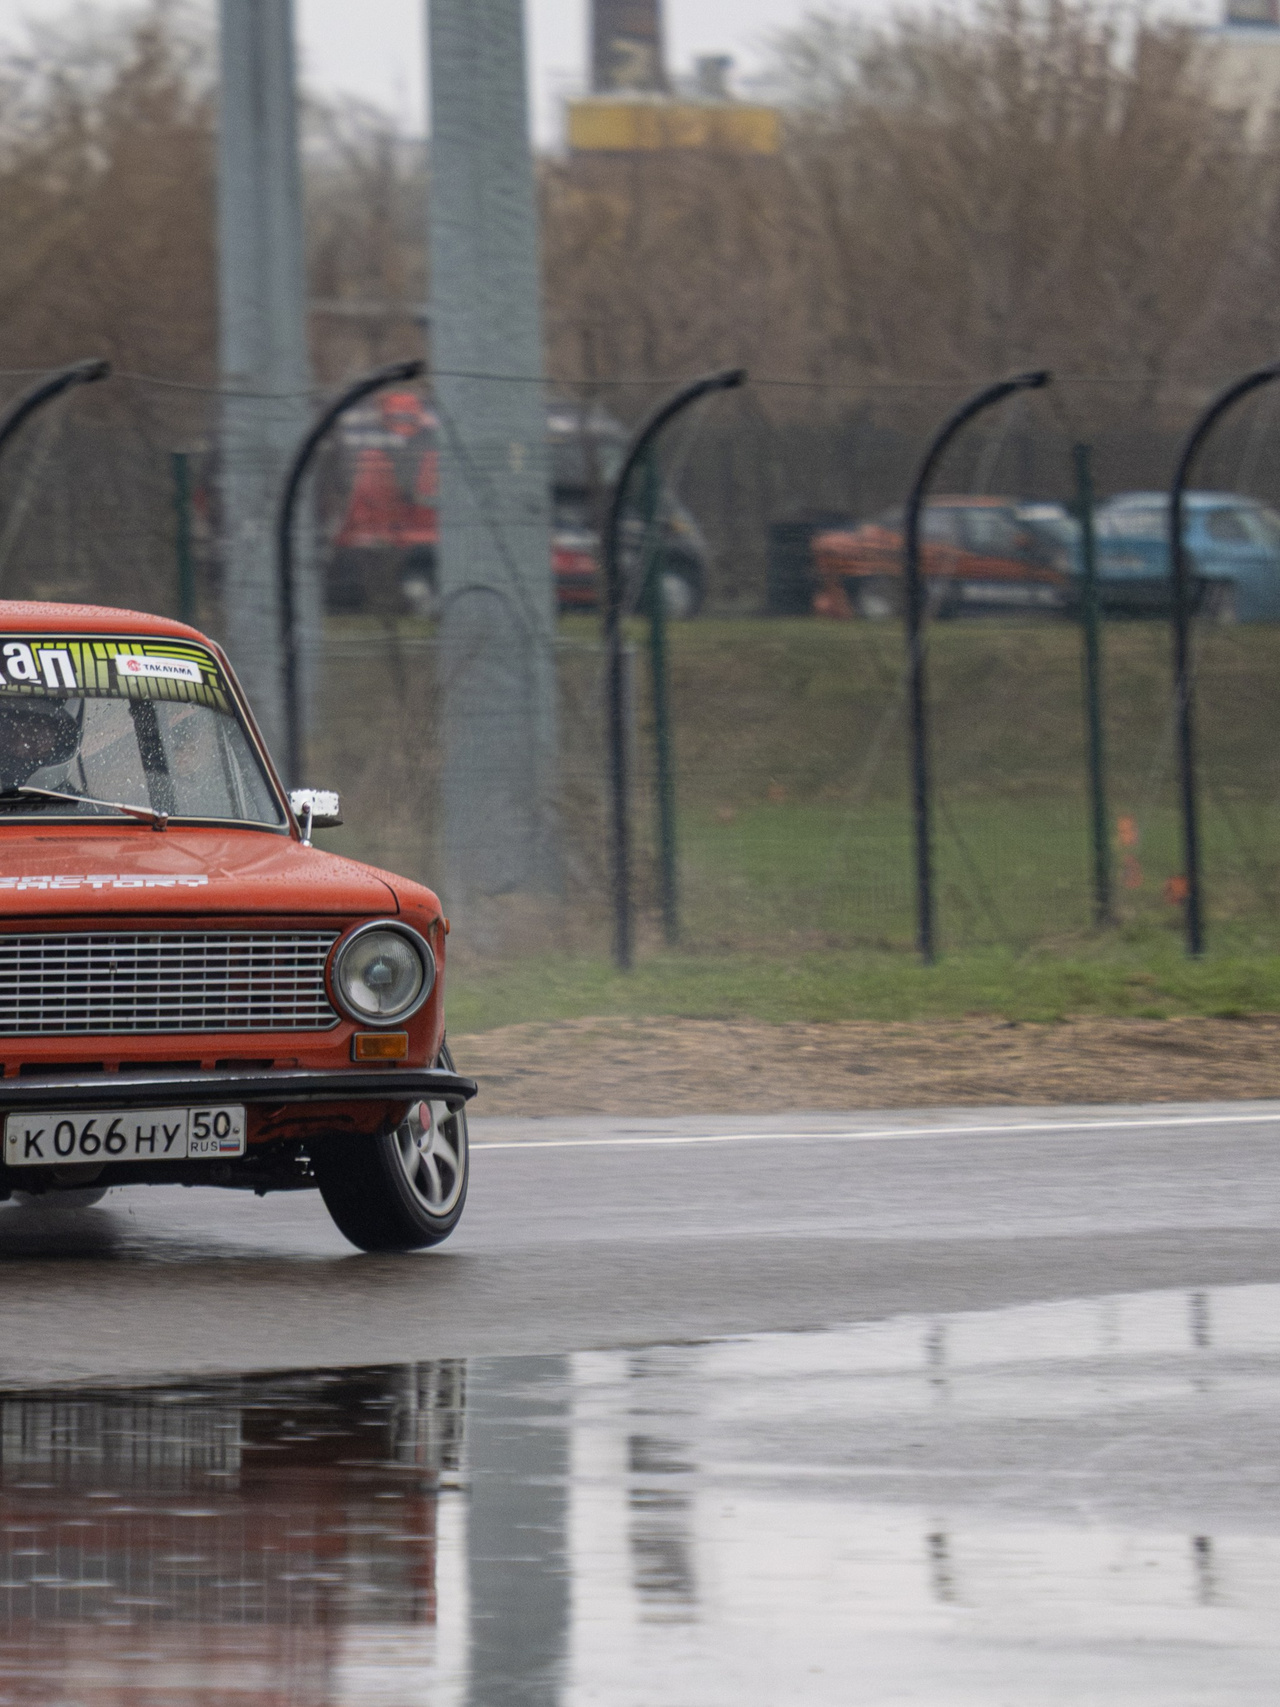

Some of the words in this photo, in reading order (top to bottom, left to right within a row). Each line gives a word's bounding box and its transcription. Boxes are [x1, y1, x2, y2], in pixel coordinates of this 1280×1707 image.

[144, 663, 193, 676] TAKAYAMA
[192, 1111, 231, 1140] 50
[191, 1141, 218, 1152] RUS
